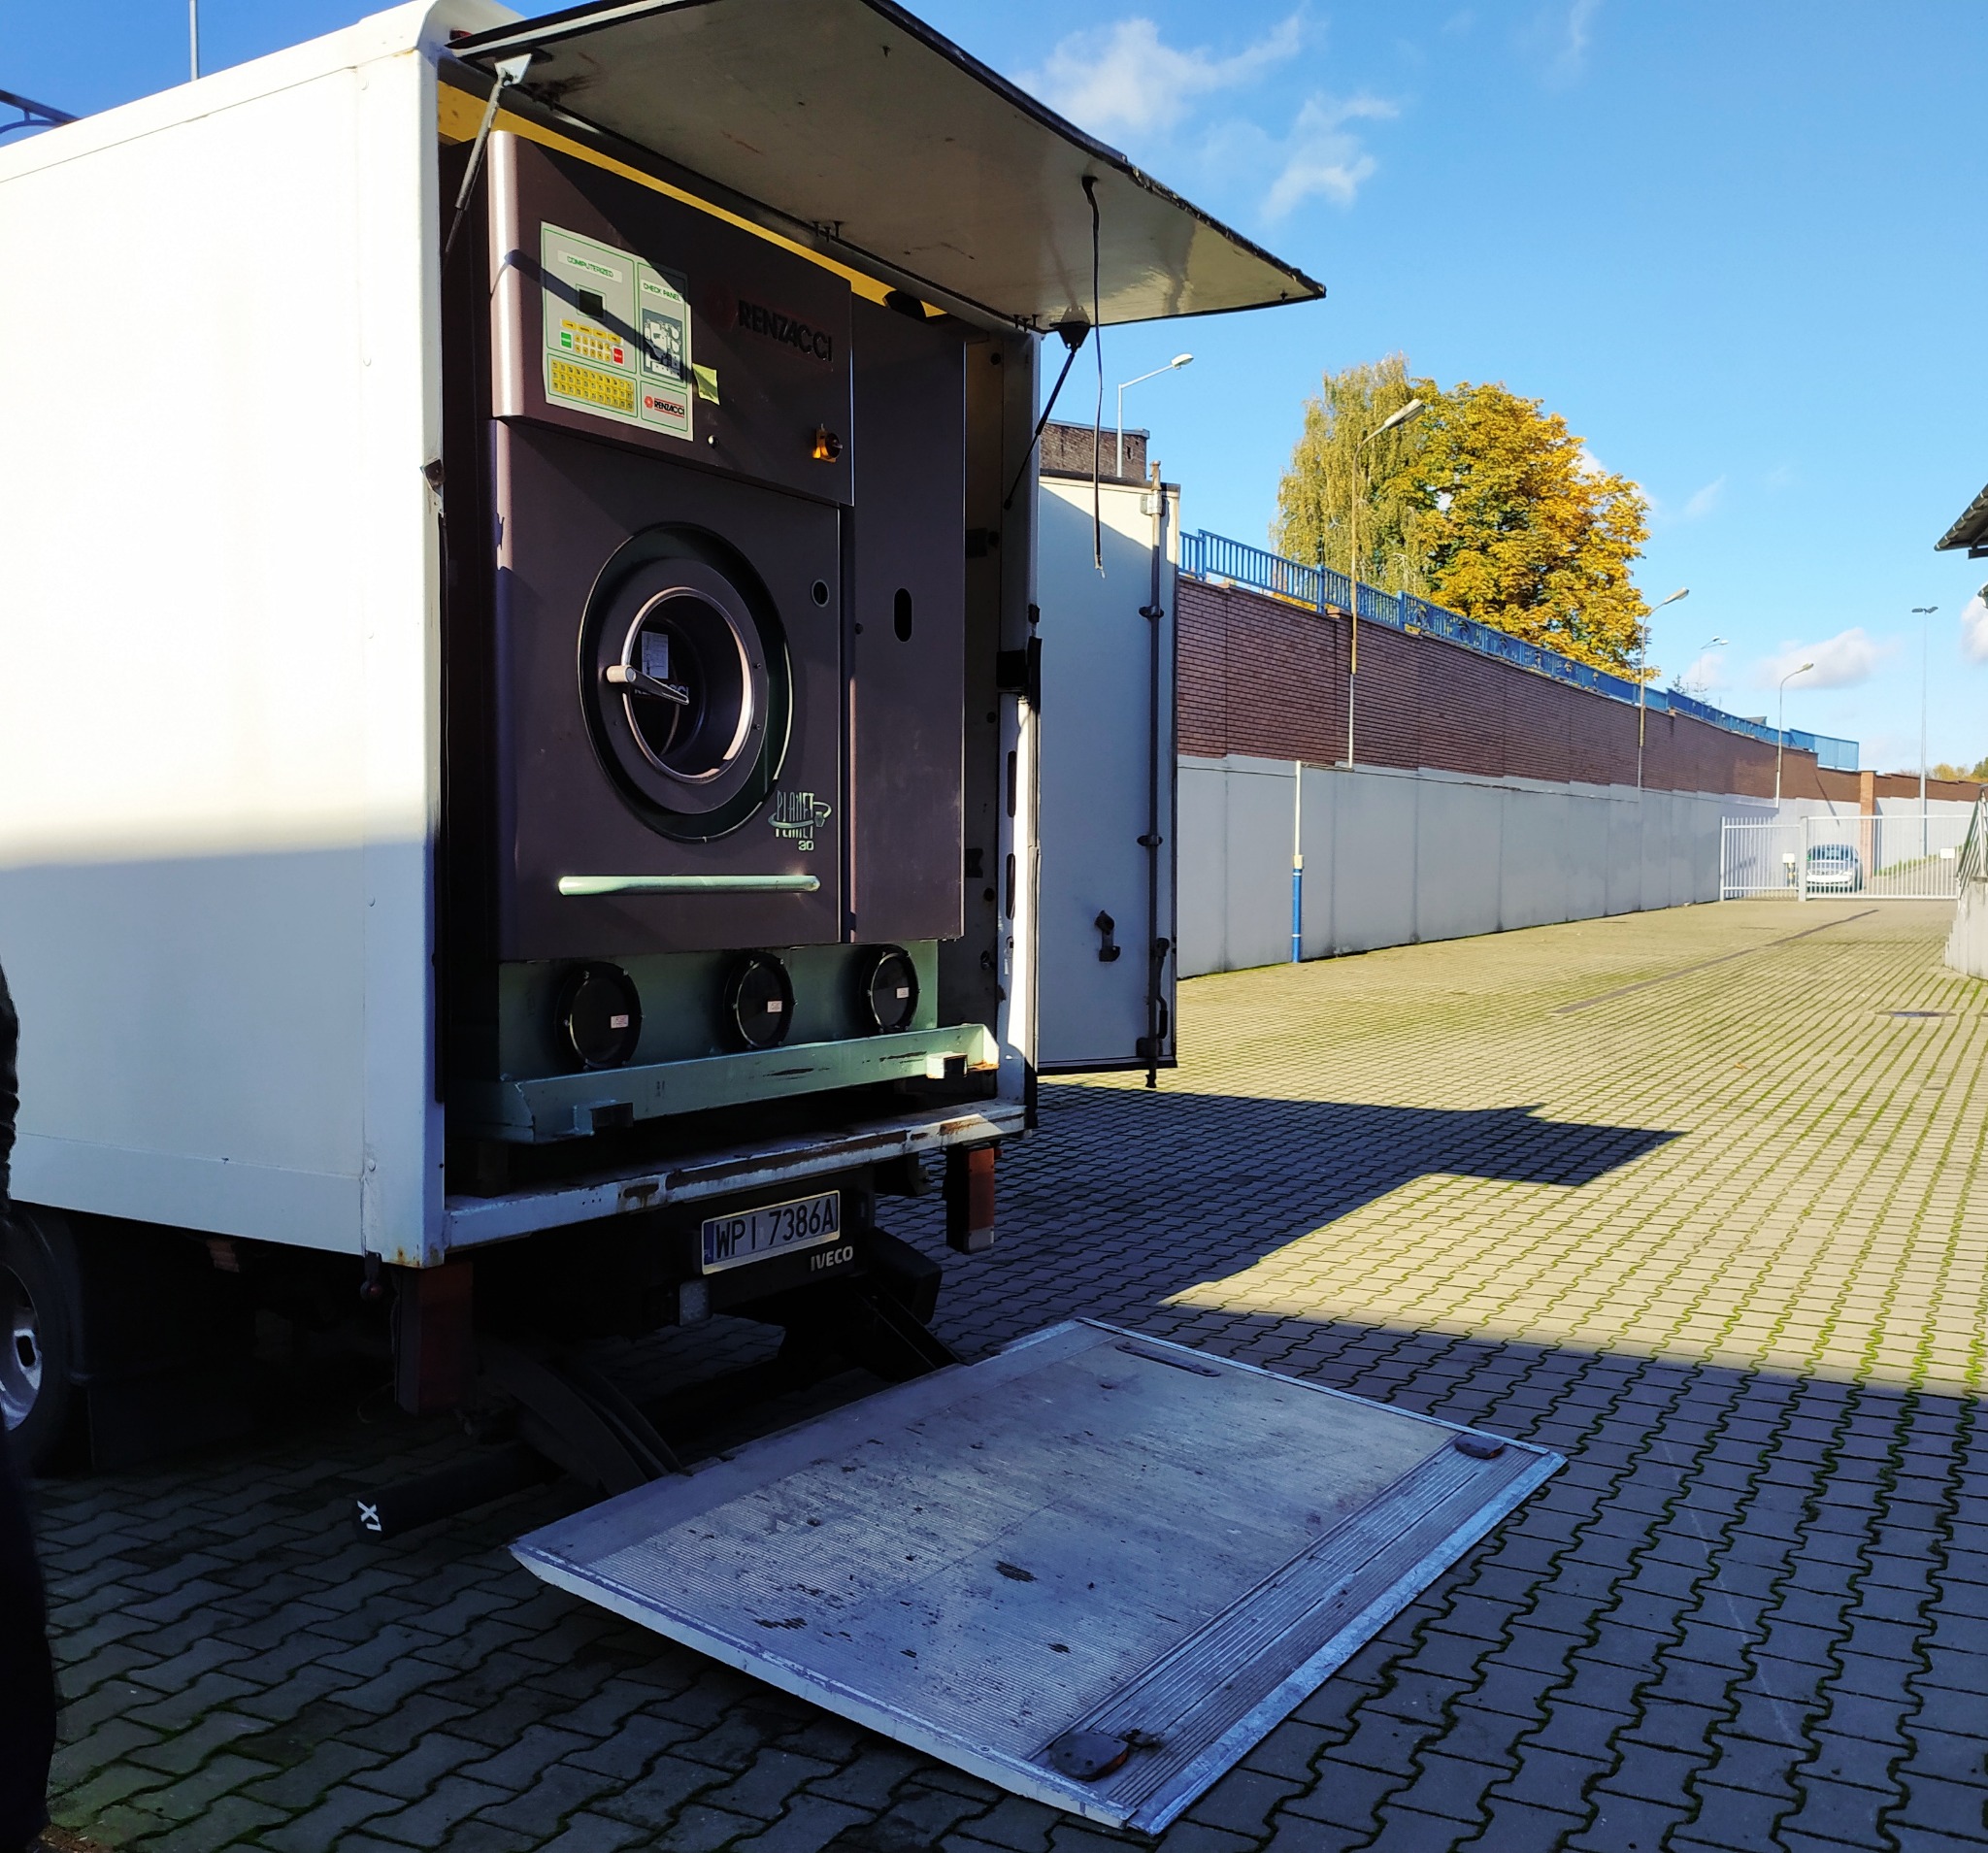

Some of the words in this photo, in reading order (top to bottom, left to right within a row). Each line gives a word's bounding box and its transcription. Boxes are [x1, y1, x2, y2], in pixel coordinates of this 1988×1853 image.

[566, 255, 614, 278] COMPUTERIZED
[643, 282, 662, 293] CHECK
[663, 289, 681, 302] PANEL
[739, 300, 833, 361] RENZACCI
[654, 400, 685, 416] RENZACCI
[715, 1216, 756, 1259] WPI
[769, 1198, 835, 1246] 7386A
[810, 1245, 854, 1272] IVECO
